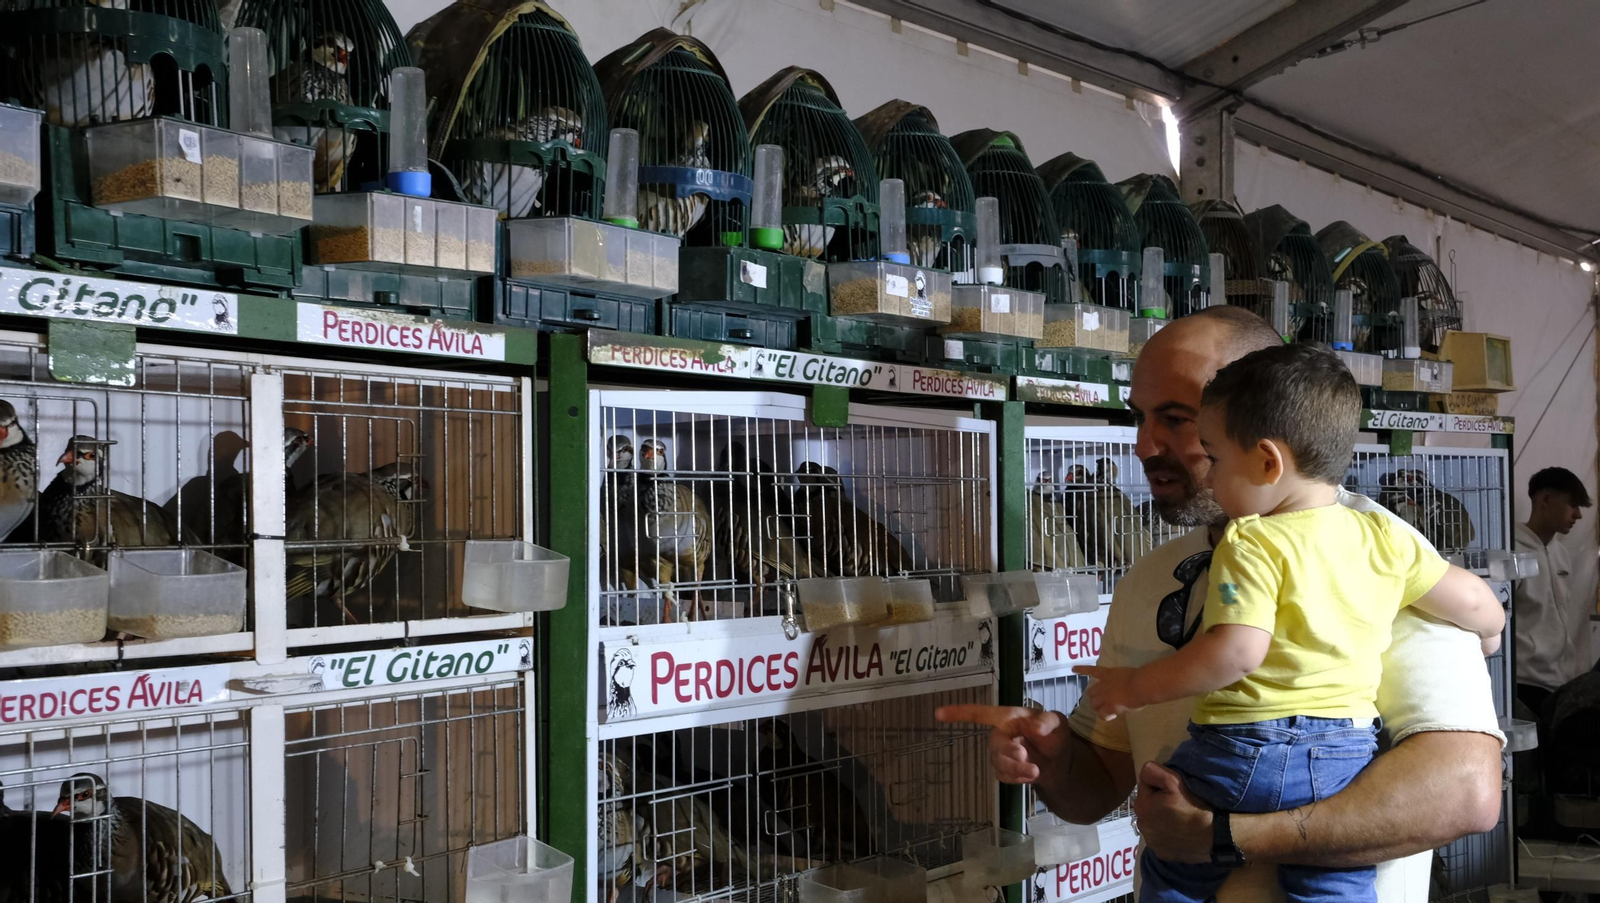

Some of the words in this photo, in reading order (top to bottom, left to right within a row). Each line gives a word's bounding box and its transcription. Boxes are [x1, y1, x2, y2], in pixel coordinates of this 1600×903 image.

[323, 310, 423, 349] PERDICES
[611, 345, 687, 369] PERDICES
[768, 353, 797, 379] "El
[803, 357, 882, 386] Gitano"
[913, 370, 964, 395] PERDICES
[1388, 413, 1435, 429] Gitano"
[1454, 416, 1486, 432] PERDICES
[330, 654, 376, 688] "El
[386, 643, 510, 683] Gitano"
[650, 651, 799, 705] PERDICES
[805, 633, 884, 686] ÁVILA
[889, 651, 912, 675] "El
[915, 640, 974, 673] Gitano"
[0, 685, 120, 723] ERDICES
[127, 673, 203, 709] ÁVILA
